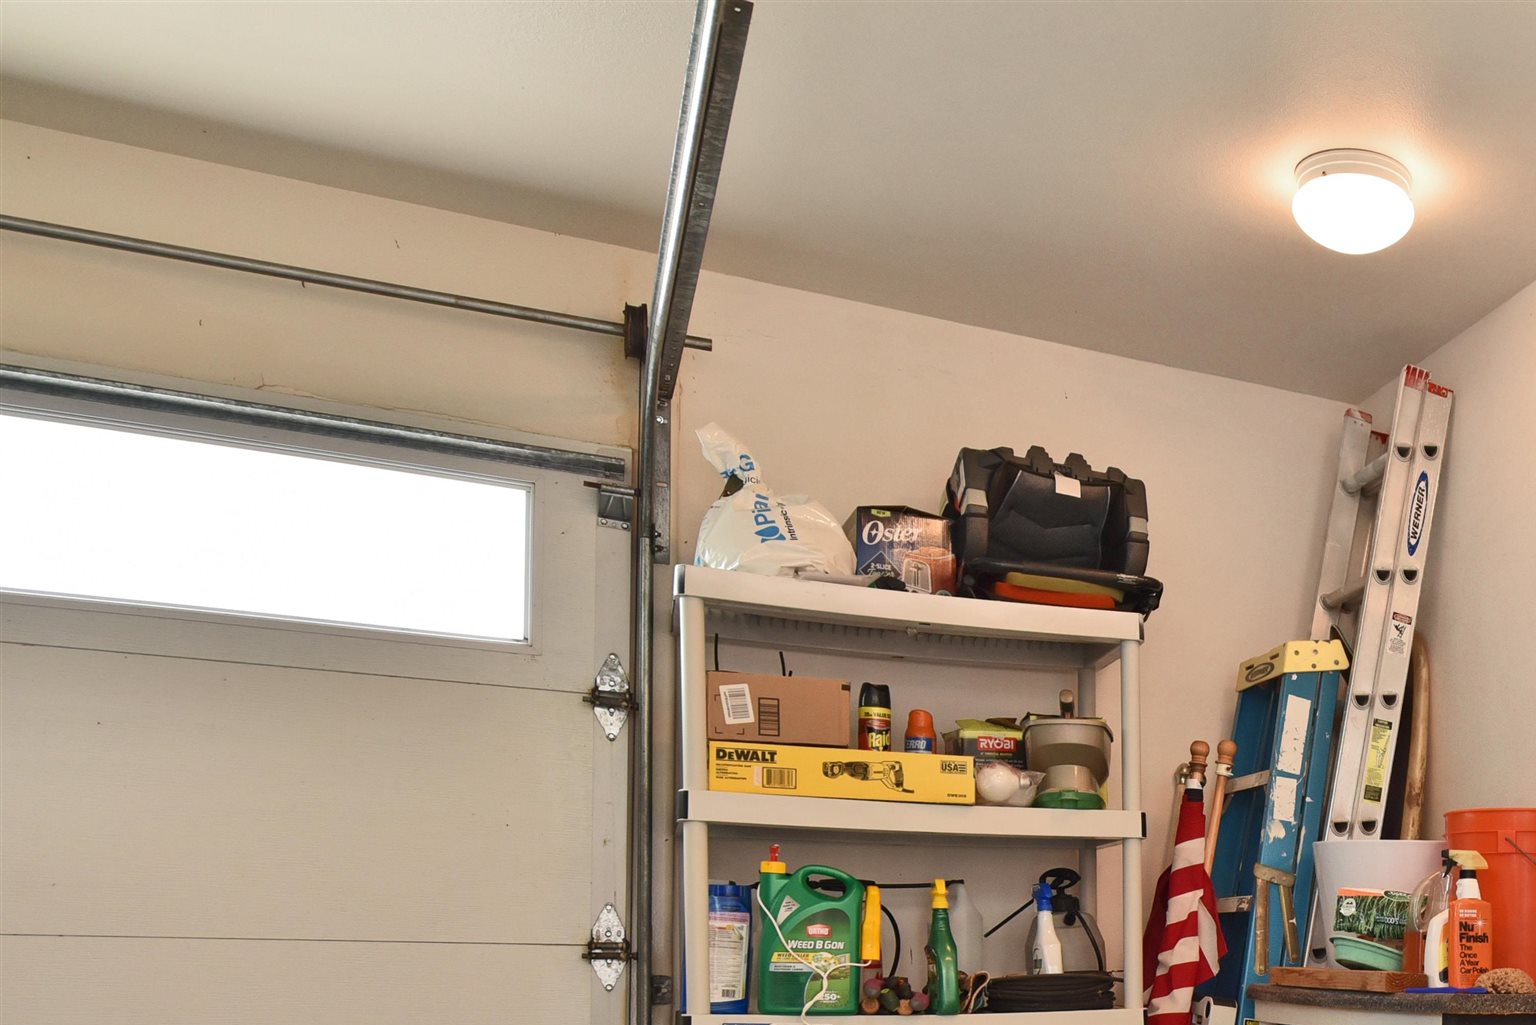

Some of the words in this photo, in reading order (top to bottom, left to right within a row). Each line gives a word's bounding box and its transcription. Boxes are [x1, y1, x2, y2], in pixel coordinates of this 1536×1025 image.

[1410, 486, 1425, 540] WERNER
[862, 520, 923, 545] Oster
[979, 739, 1014, 750] RYOBI
[941, 763, 959, 772] USA
[1459, 921, 1474, 932] Nu
[1459, 933, 1489, 943] Finish
[788, 940, 814, 949] WEED
[815, 941, 823, 949] B
[824, 941, 845, 950] GON
[1460, 951, 1477, 959] Once
